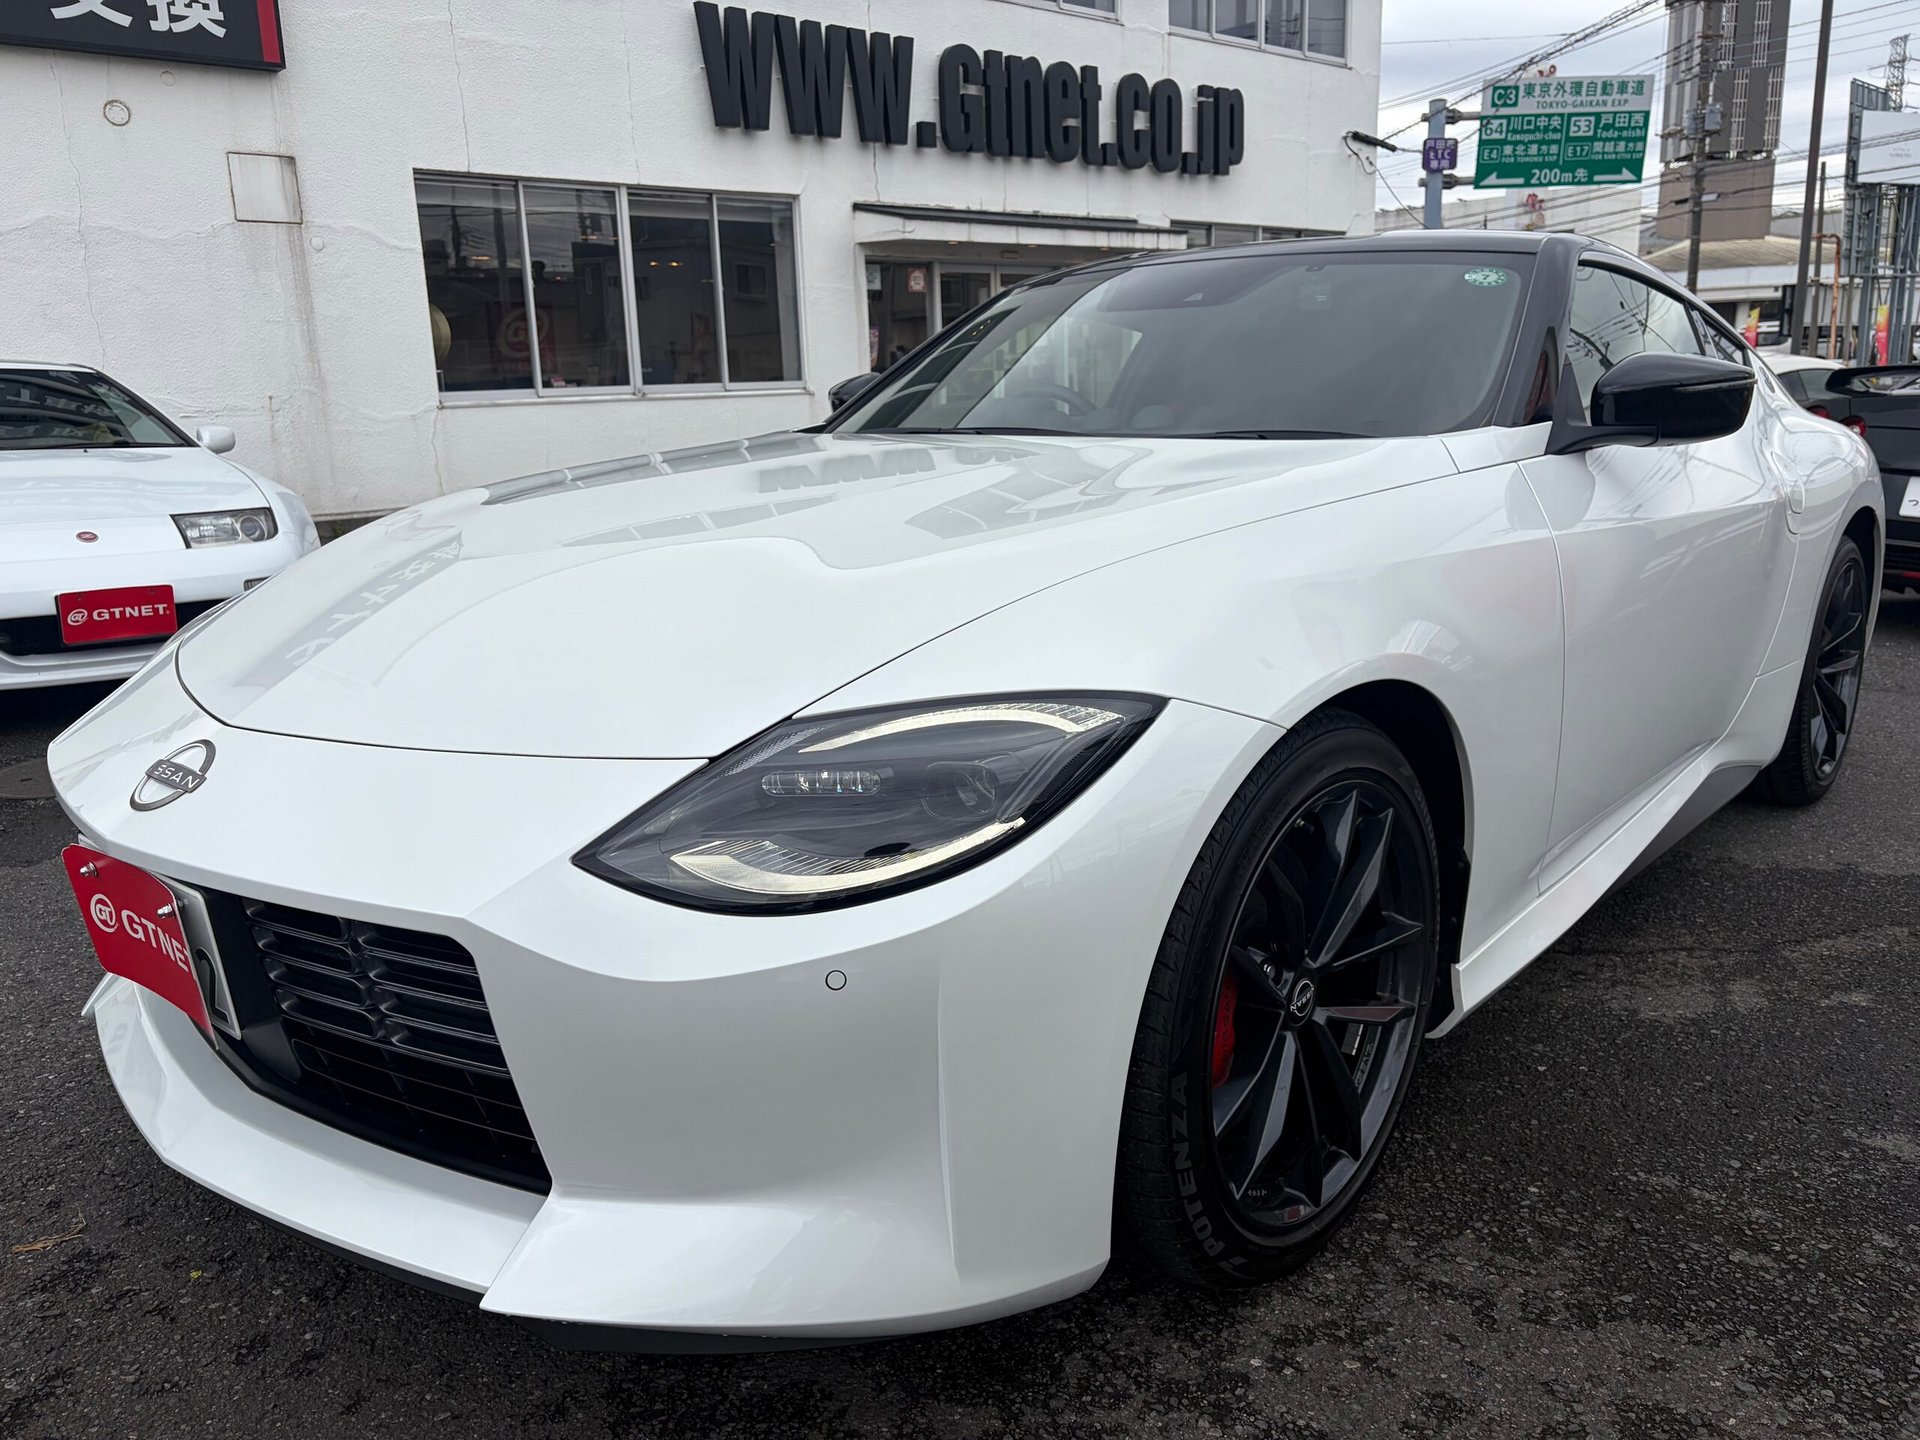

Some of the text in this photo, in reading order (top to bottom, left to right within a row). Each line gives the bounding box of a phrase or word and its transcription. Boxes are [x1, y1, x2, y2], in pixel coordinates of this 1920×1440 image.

[1494, 88, 1516, 105] C3
[1521, 80, 1645, 99] 東京外環自動車道
[1536, 98, 1629, 109] TOKYO-GAIKAN EXP
[1508, 115, 1562, 130] 川口中央
[1572, 119, 1593, 134] 53
[1599, 113, 1645, 128] 戸田西
[1484, 121, 1504, 137] 64
[1429, 149, 1451, 159] ETC
[1483, 148, 1498, 160] E4
[1567, 146, 1589, 157] E17
[92, 604, 168, 620] GTNET
[153, 764, 200, 789] SSAN
[121, 909, 191, 973] GTNE
[1171, 1071, 1226, 1257] POTENZA
